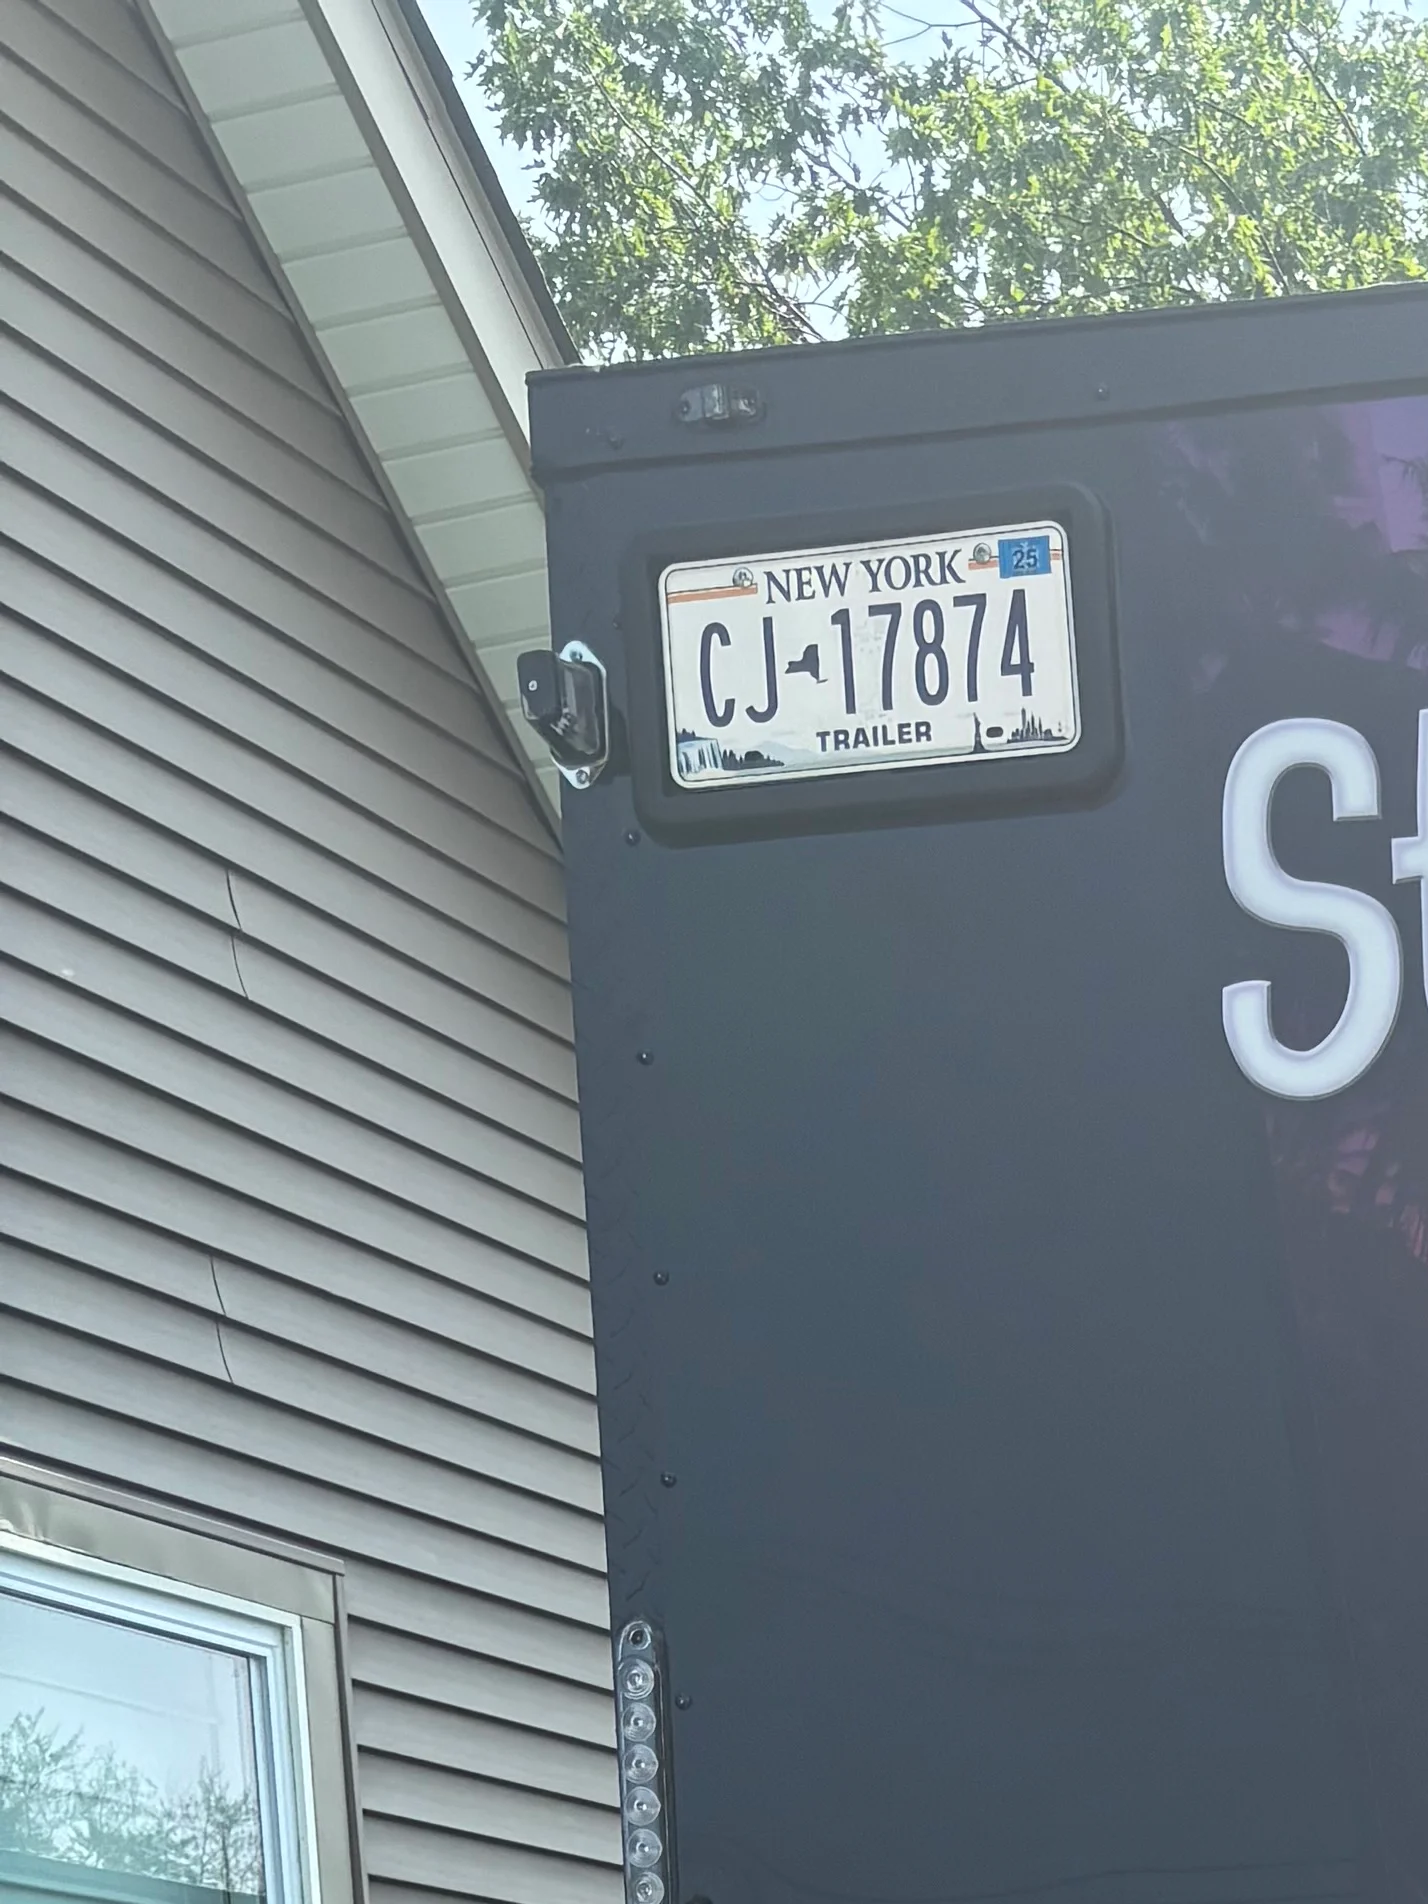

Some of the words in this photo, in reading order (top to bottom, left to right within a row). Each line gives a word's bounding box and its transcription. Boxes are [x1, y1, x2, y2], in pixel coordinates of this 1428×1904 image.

[763, 562, 851, 604] NEW
[858, 548, 967, 591] YORK
[1012, 548, 1038, 570] 25
[830, 588, 1036, 715] 17874
[815, 720, 933, 753] TRAILER
